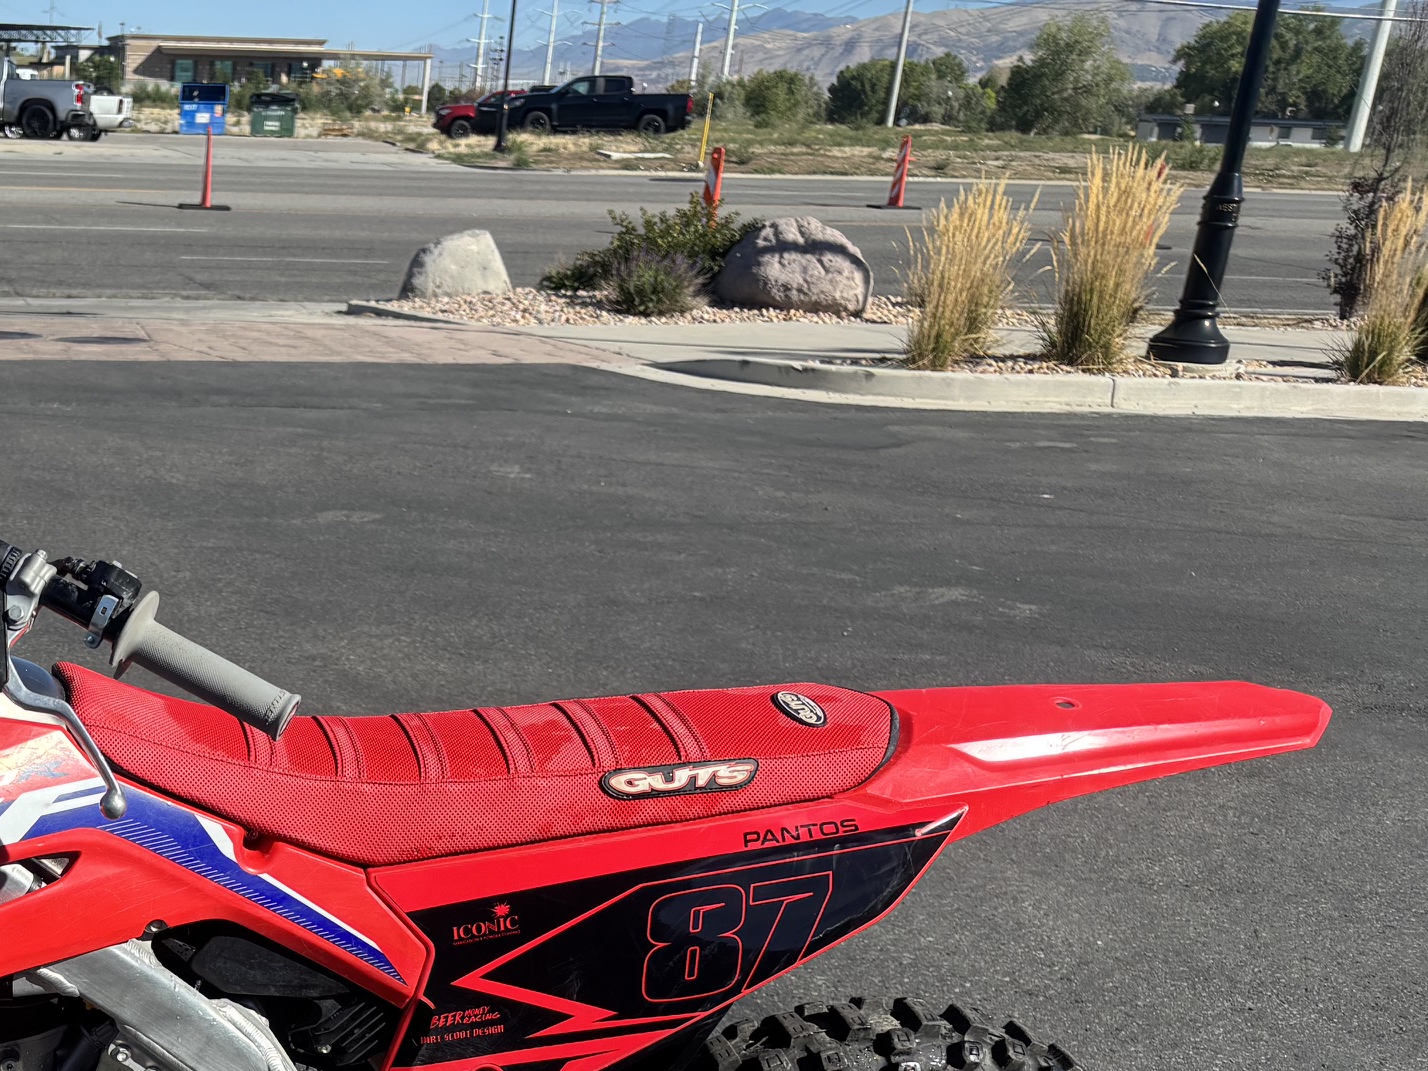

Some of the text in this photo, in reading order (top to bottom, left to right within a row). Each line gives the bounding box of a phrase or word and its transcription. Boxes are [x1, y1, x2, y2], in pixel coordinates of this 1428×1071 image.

[609, 761, 754, 795] GUTS
[743, 818, 860, 848] PANTOS
[452, 915, 519, 940] ICONIC
[641, 870, 833, 1003] 87
[430, 1011, 464, 1029] BEER
[463, 1011, 501, 1024] RACING
[464, 1005, 491, 1018] MONEY
[473, 1024, 505, 1037] DESIGN
